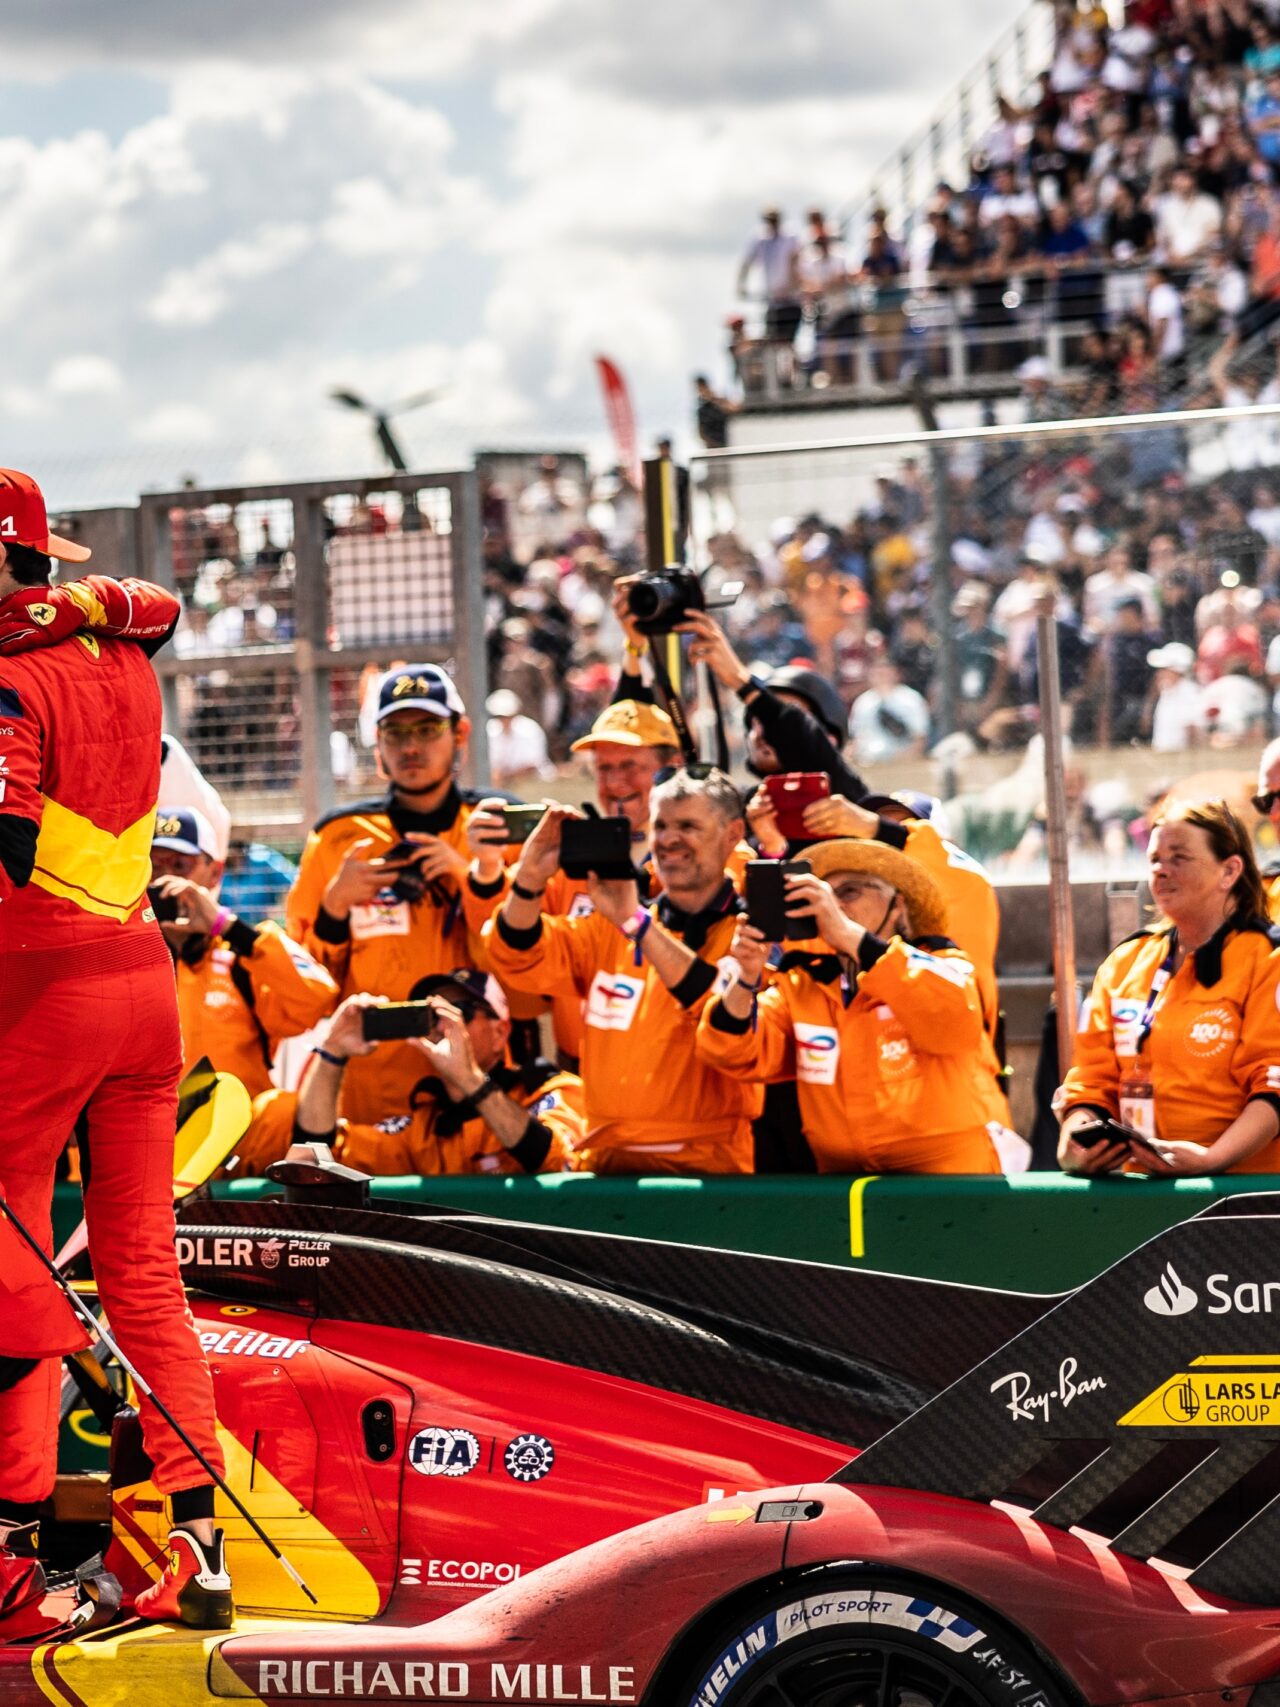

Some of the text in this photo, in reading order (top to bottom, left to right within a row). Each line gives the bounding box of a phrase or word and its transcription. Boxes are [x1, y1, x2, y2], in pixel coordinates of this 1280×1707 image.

[1190, 1023, 1221, 1039] 100
[175, 1238, 254, 1267] DLER
[200, 1330, 311, 1359] etilar
[1205, 1383, 1255, 1400] LARS
[1206, 1404, 1270, 1422] GROUP
[788, 1600, 893, 1625] PILOT SPORT
[694, 1625, 767, 1707] HELIN
[258, 1659, 636, 1701] RICHARD MILLE
